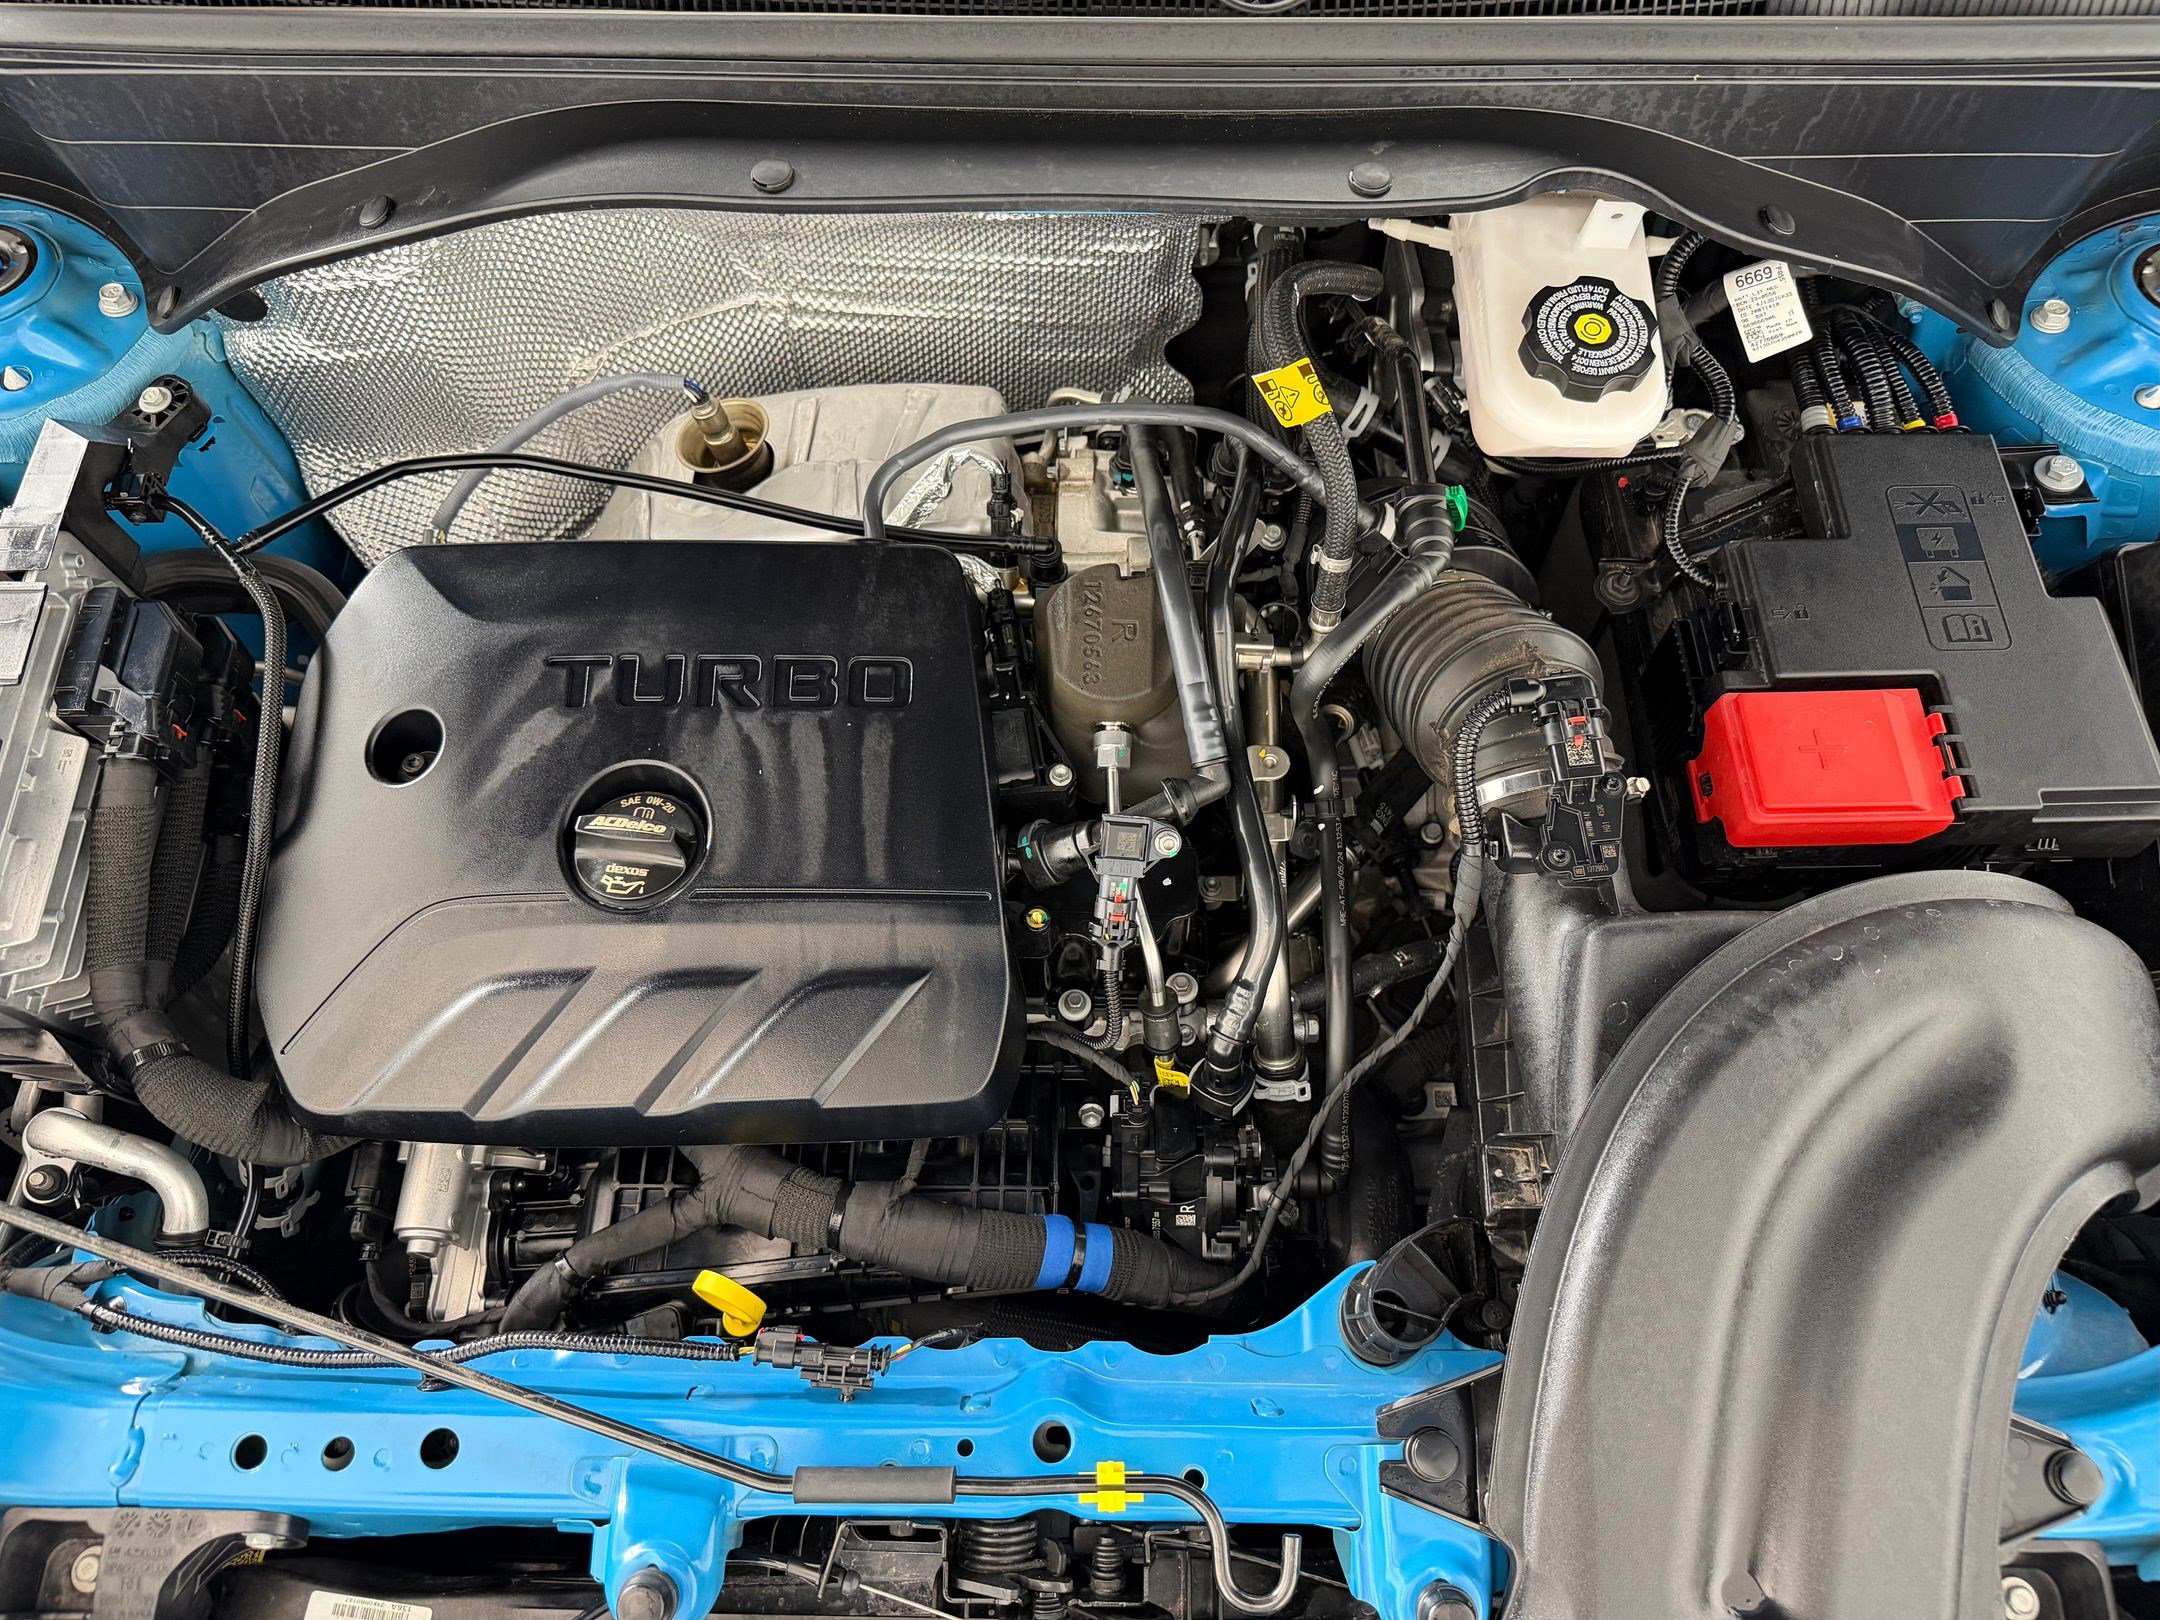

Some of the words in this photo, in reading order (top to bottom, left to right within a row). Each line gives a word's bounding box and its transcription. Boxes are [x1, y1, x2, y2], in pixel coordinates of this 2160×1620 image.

[1735, 266, 1773, 288] 6669
[1547, 289, 1568, 304] FROM
[1567, 284, 1588, 293] FLUID
[1591, 294, 1607, 302] CAP
[1082, 579, 1103, 686] 12670563
[1111, 618, 1139, 643] R
[547, 653, 916, 710] TURBO
[620, 795, 641, 808] SAE
[645, 795, 677, 815] 0W-20
[588, 816, 667, 834] ACDelco
[605, 863, 650, 877] dexos
[1179, 1204, 1196, 1213] R
[391, 1603, 412, 1613] 136A
